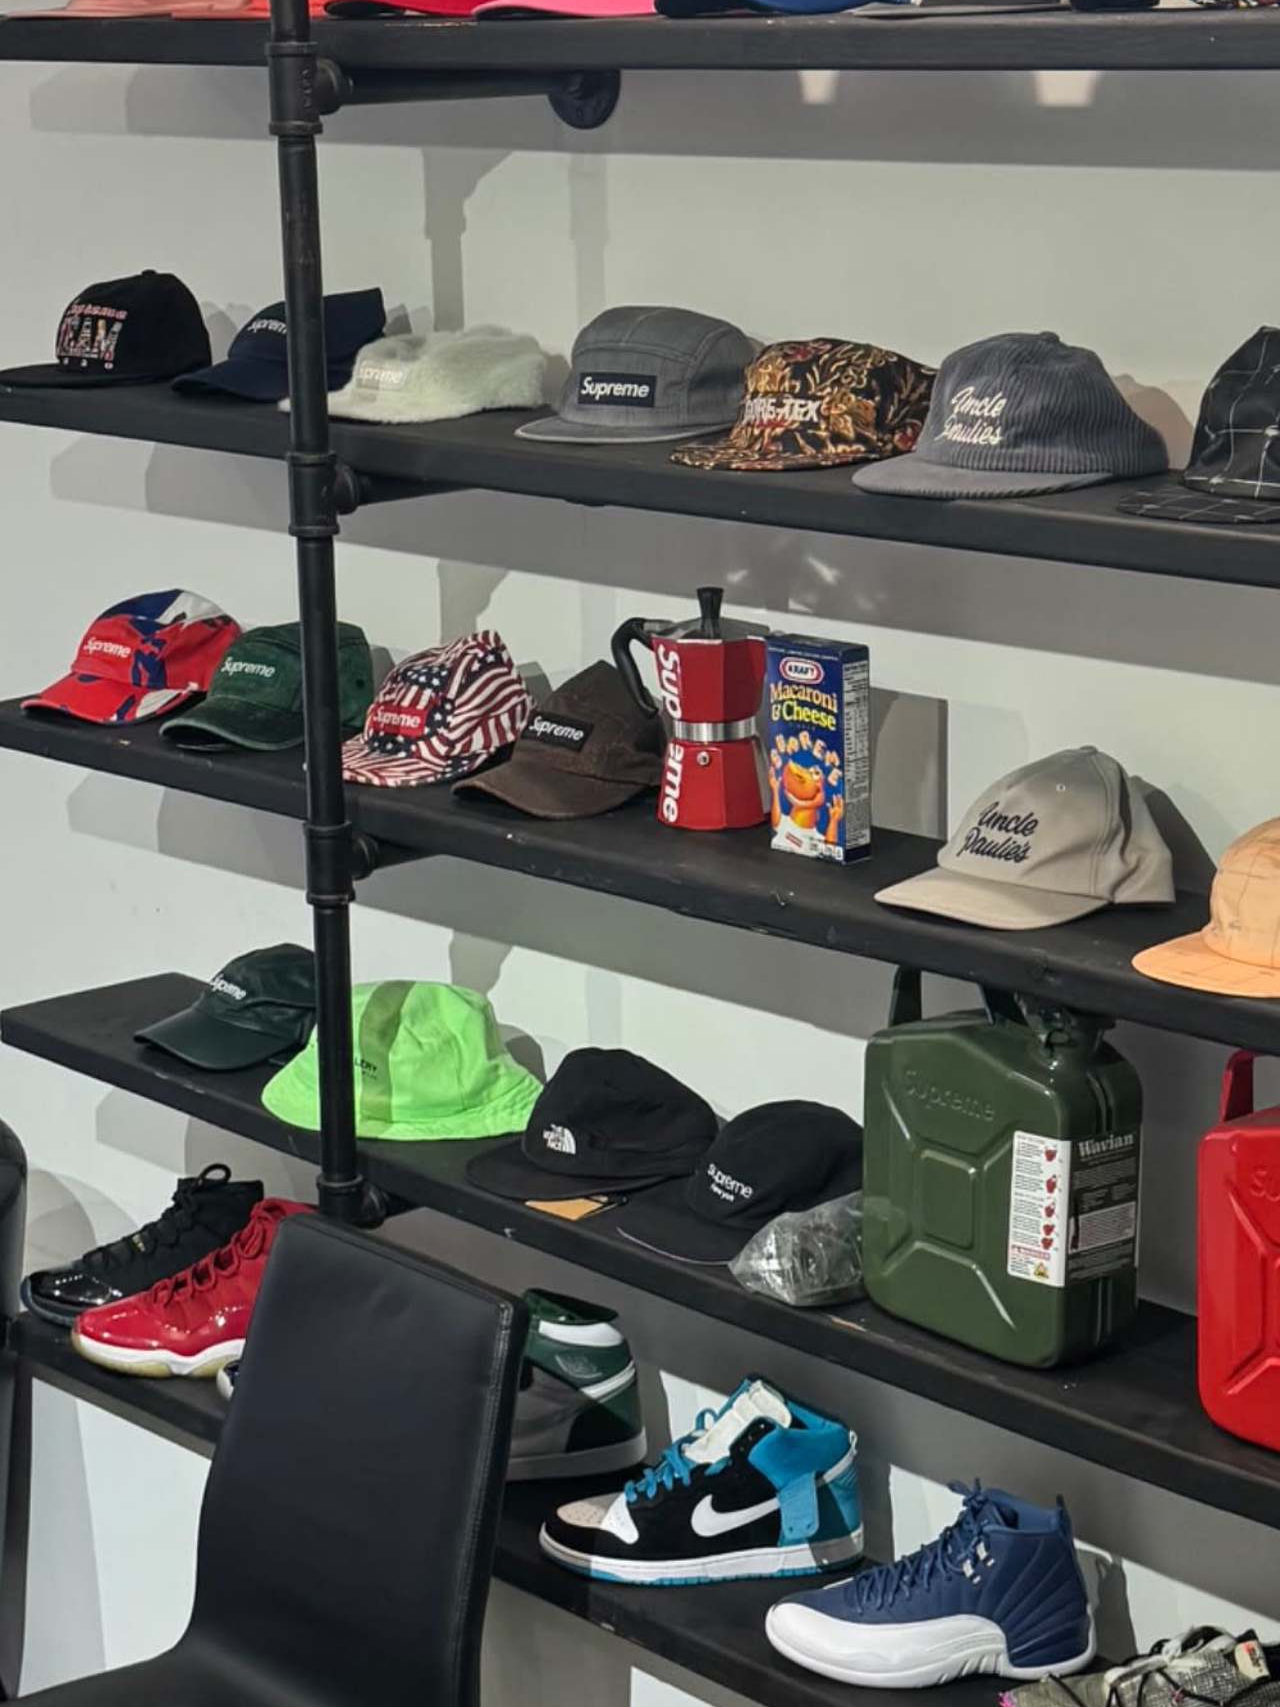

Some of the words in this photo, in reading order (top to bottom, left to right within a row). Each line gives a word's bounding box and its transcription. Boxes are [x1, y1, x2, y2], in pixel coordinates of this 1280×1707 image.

[580, 376, 650, 401] Supreme
[84, 636, 132, 659] Supreme
[221, 656, 276, 678] Supreme
[770, 680, 838, 714] Macaroni
[373, 706, 421, 730] Supreme
[782, 699, 837, 731] Cheese
[528, 715, 585, 742] Supreme
[978, 801, 1039, 837] Uncle
